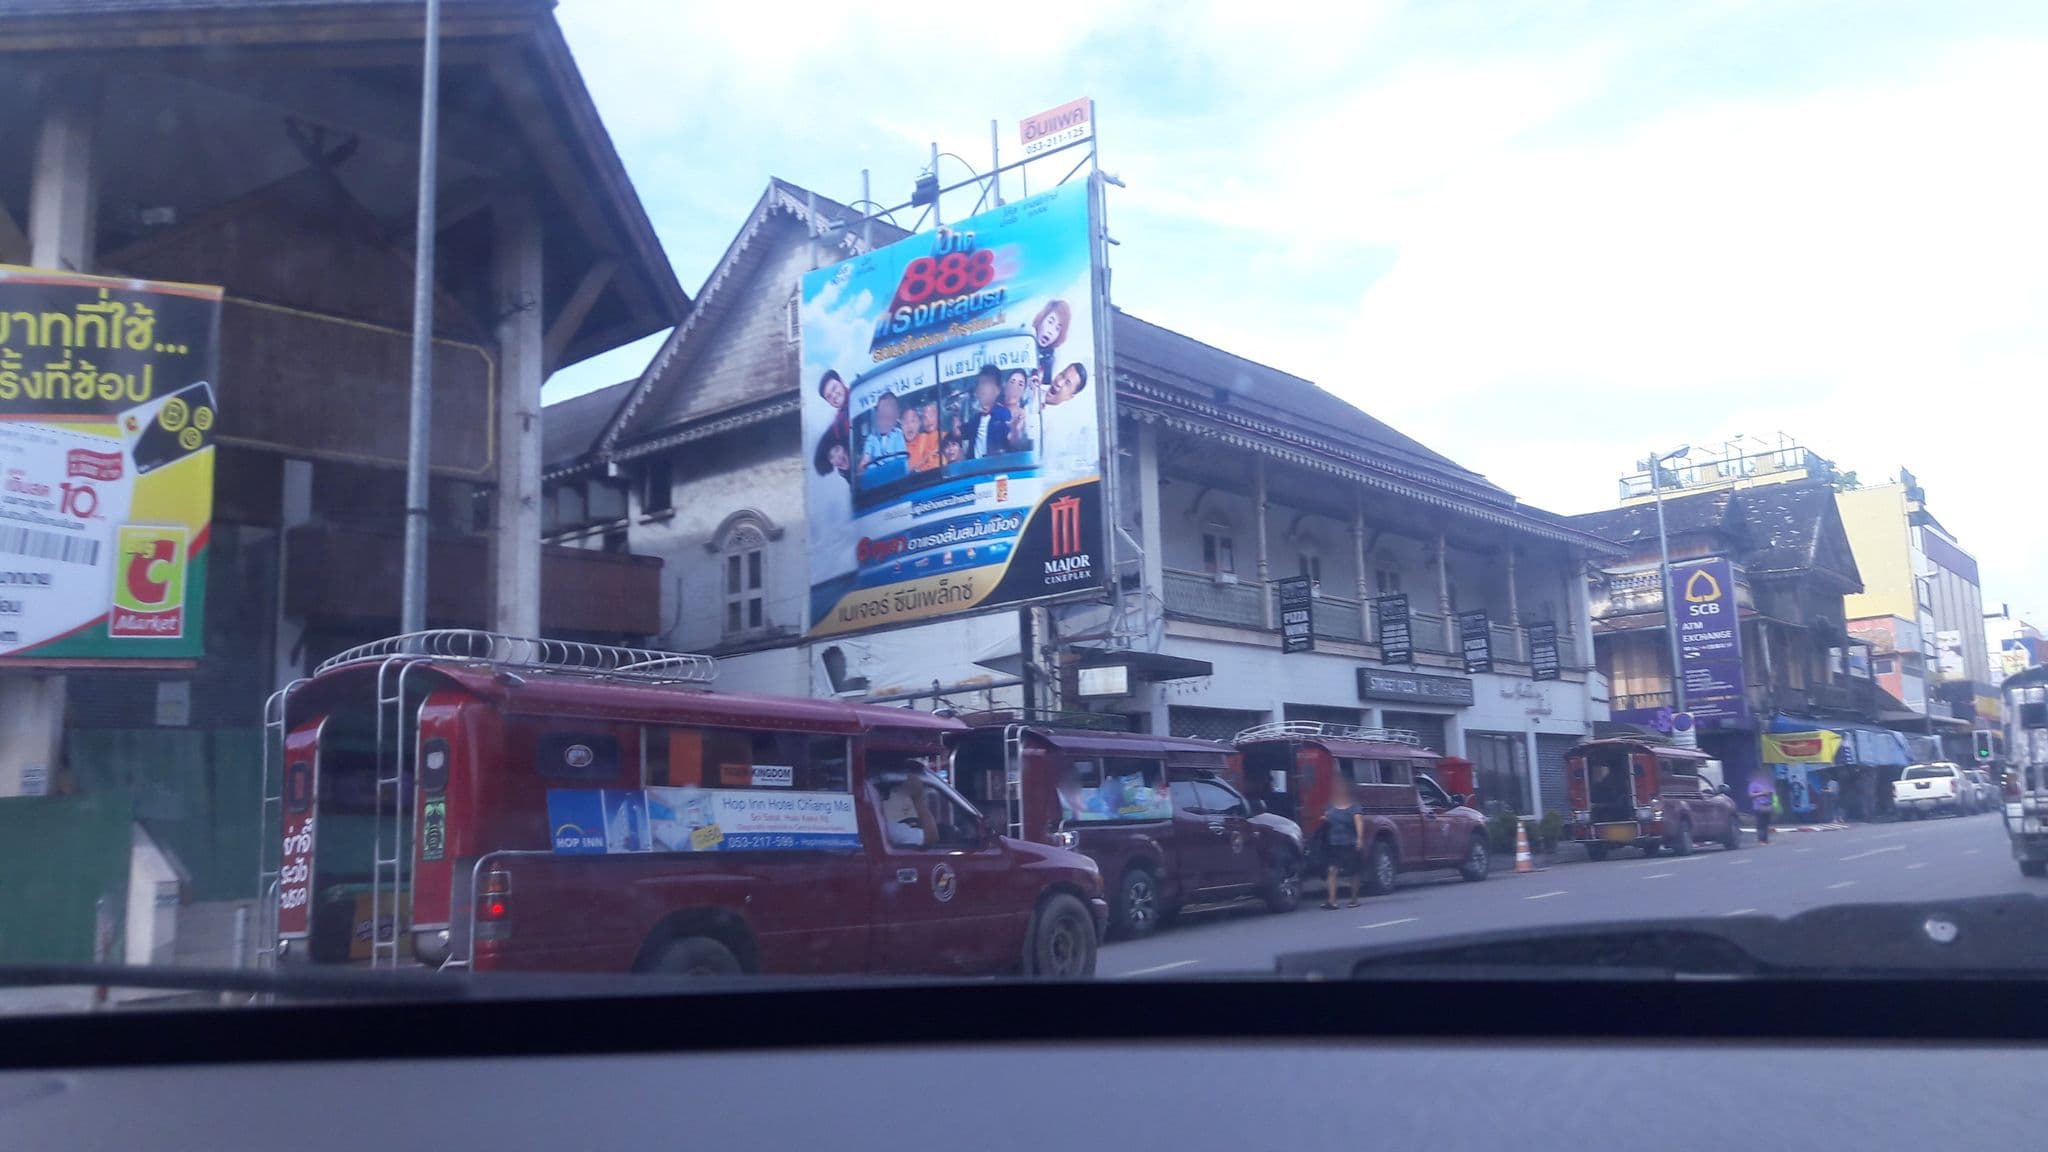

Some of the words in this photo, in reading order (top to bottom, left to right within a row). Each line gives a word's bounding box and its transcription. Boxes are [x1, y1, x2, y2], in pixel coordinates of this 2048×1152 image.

[899, 248, 995, 302] 888
[1044, 554, 1091, 574] MAJOR
[1044, 570, 1092, 585] CINEPLEX
[1689, 602, 1721, 616] SCB
[114, 614, 178, 632] Market
[1682, 621, 1704, 631] ATM
[1682, 630, 1733, 643] EXCHANGE
[751, 768, 791, 779] KINGDOM
[722, 799, 745, 812] Hop
[769, 799, 793, 810] Hotel
[797, 799, 832, 815] Chiang
[556, 837, 580, 848] HOP
[581, 837, 604, 848] INN
